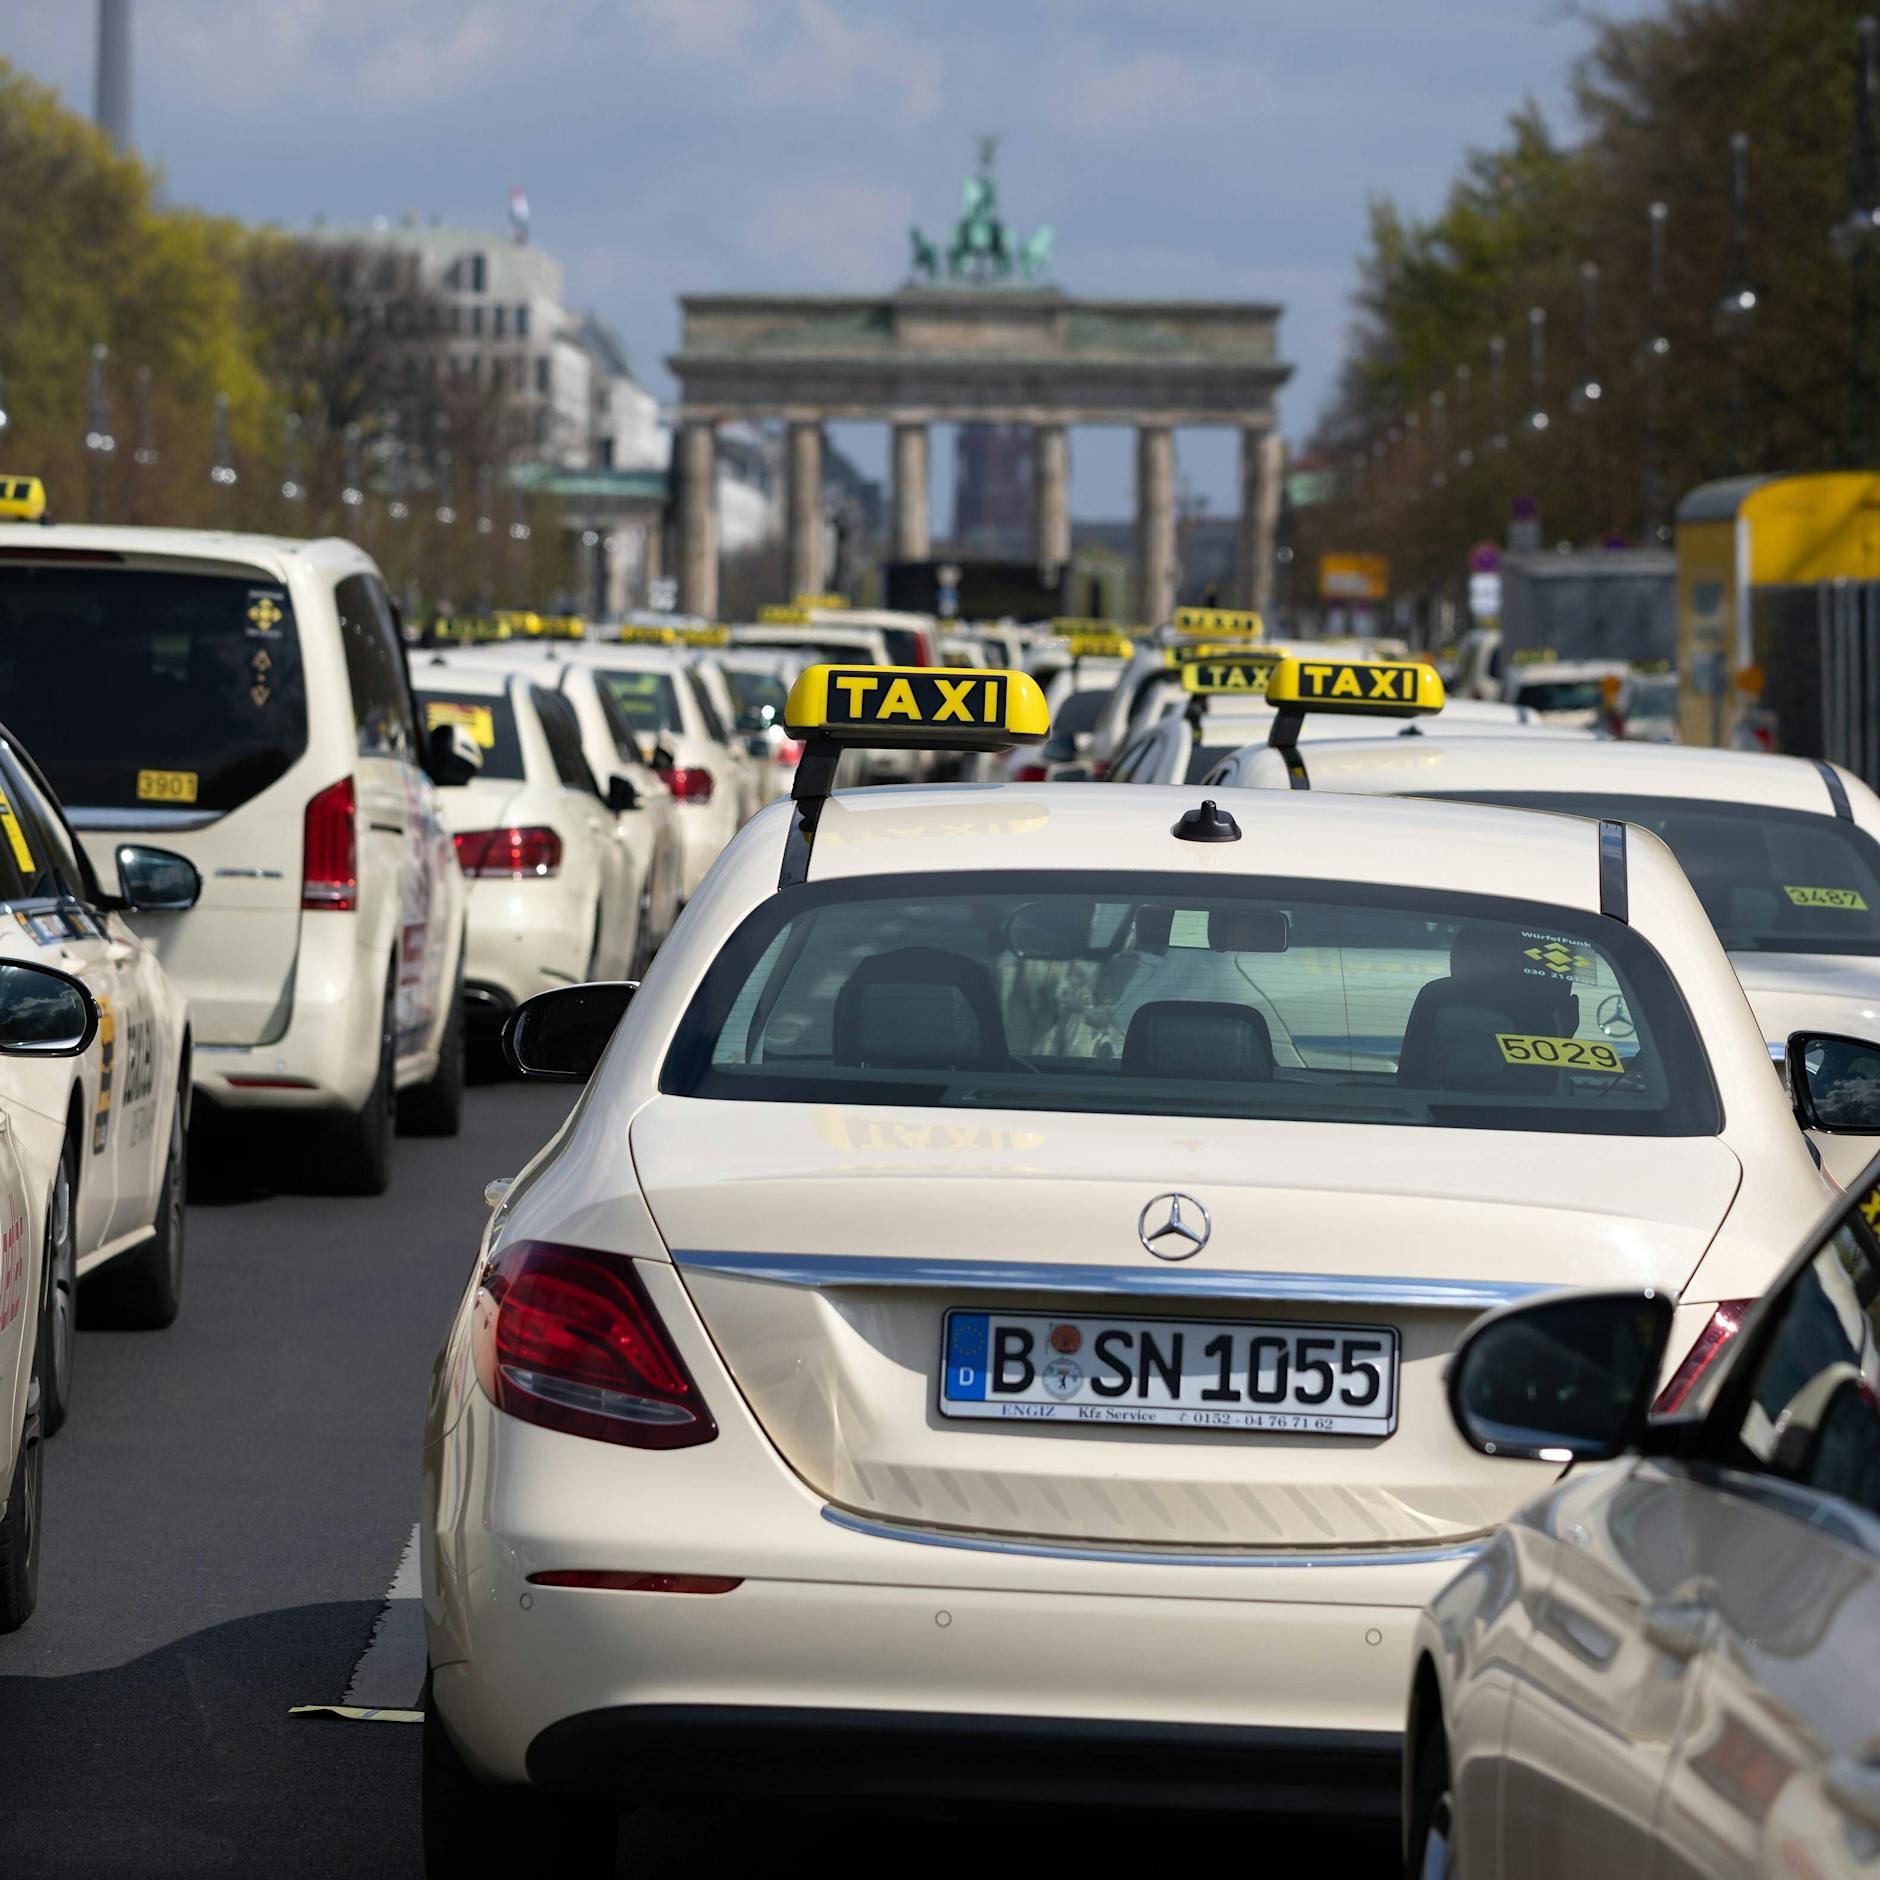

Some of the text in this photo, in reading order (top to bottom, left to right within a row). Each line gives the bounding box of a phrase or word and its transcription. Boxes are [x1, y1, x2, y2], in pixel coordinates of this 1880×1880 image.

[1208, 666, 1269, 688] TAX
[1304, 666, 1413, 700] TAXI
[836, 676, 998, 723] TAXI
[141, 773, 197, 797] 3901
[1790, 888, 1858, 907] 3487
[1523, 967, 1546, 976] 030
[1501, 1037, 1618, 1068] 5029
[959, 1367, 974, 1387] D
[992, 1327, 1035, 1394] B
[1090, 1330, 1183, 1399] SN
[1201, 1334, 1382, 1407] 1055
[1002, 1404, 1056, 1417] ENGIZ
[1079, 1407, 1102, 1419] Kfz
[1106, 1408, 1157, 1421] Service
[1193, 1412, 1230, 1425] 0152
[1245, 1414, 1263, 1426] 04
[1269, 1416, 1287, 1428] 76
[1292, 1417, 1308, 1429] 71
[1315, 1418, 1333, 1430] 62
